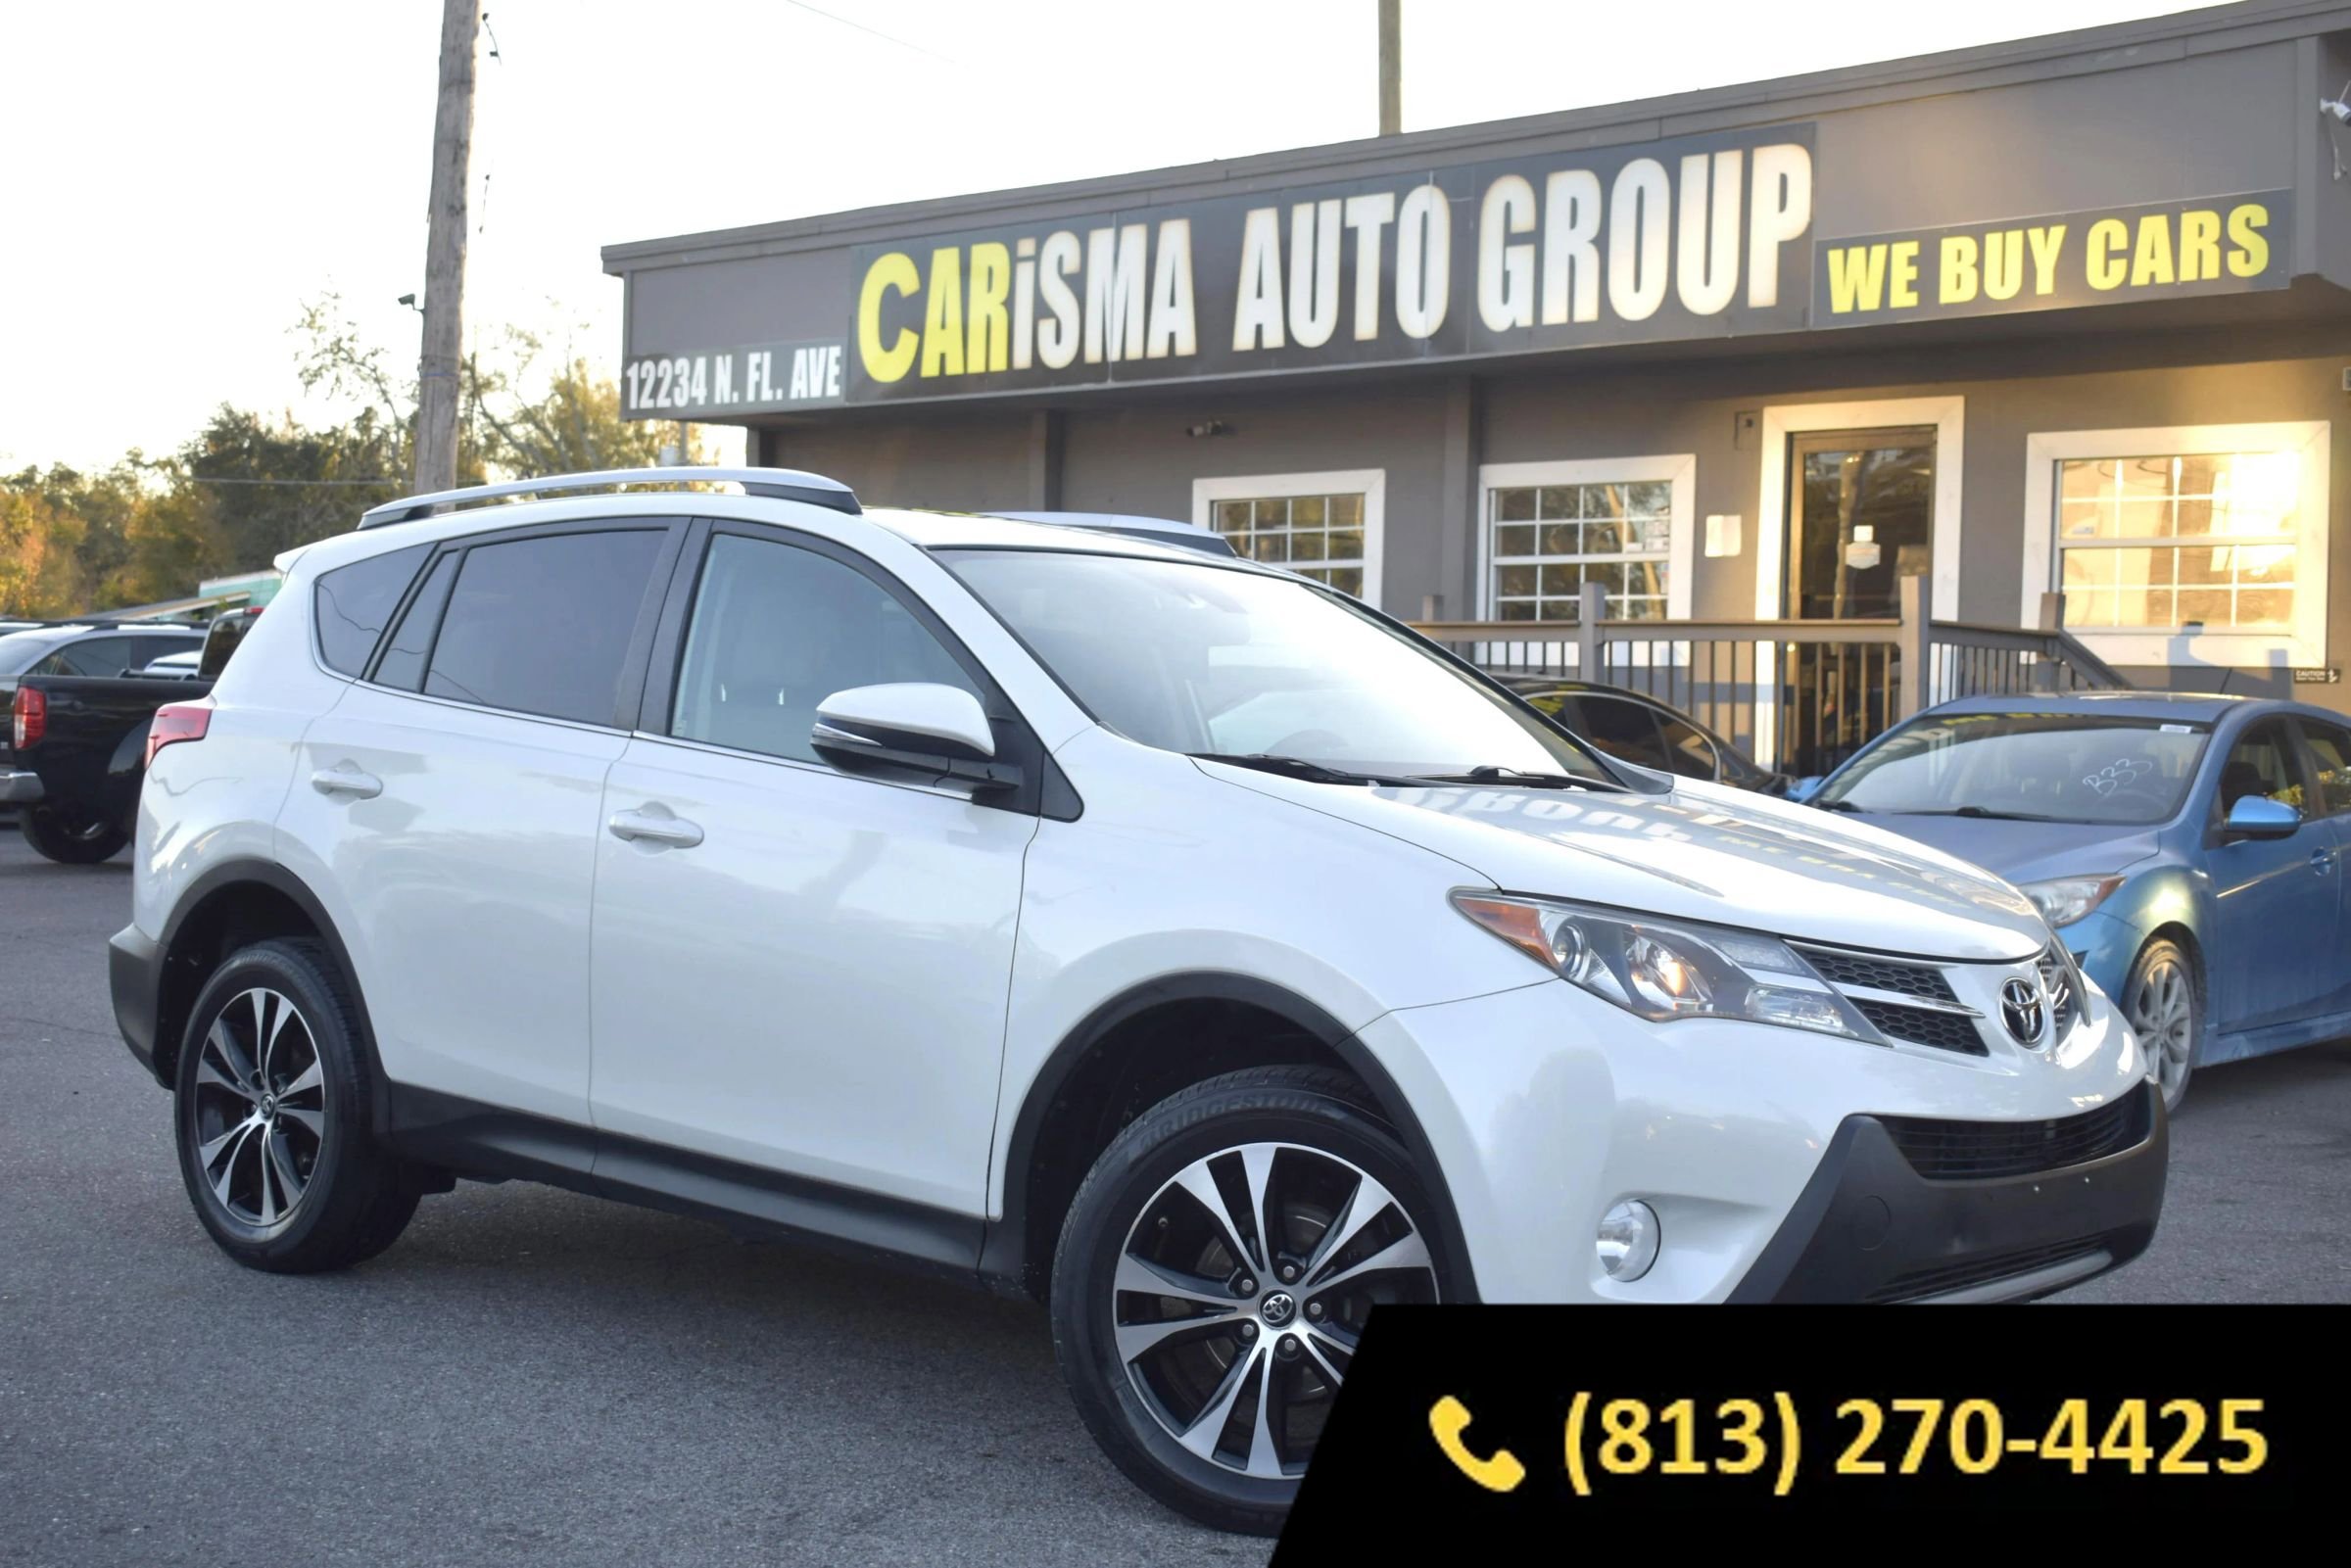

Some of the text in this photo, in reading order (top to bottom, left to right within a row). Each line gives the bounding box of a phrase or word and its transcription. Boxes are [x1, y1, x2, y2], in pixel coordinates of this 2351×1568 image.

[1231, 183, 1452, 352] AUTO
[1476, 143, 1814, 334] GROUP
[1827, 203, 2270, 314] WE BUY CARS
[626, 345, 843, 410] 12234 N. FL. AVE
